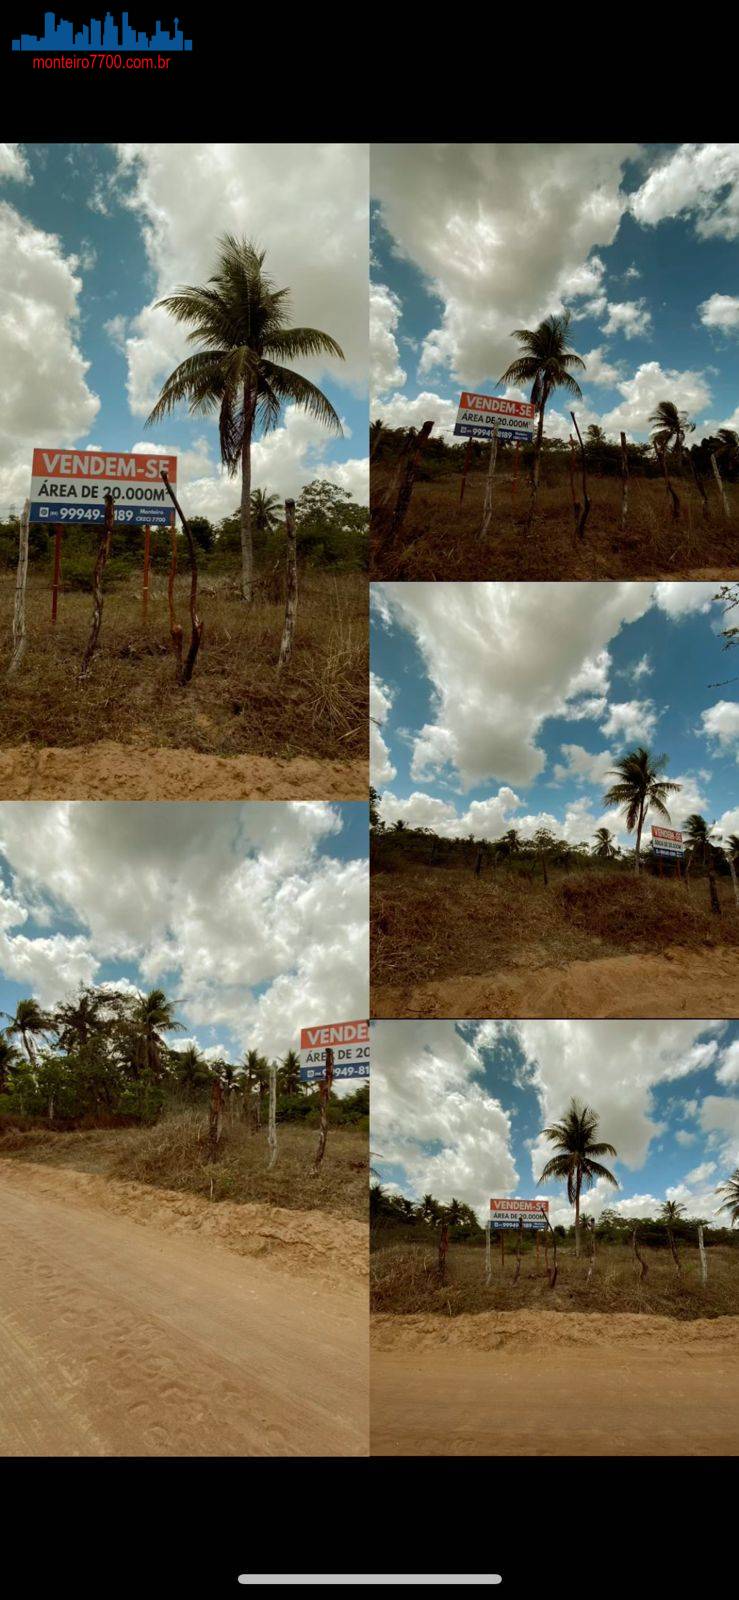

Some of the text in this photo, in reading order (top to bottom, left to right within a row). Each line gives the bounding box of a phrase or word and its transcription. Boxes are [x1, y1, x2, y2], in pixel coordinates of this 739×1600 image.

[467, 395, 532, 417] VENDEM-SE
[42, 453, 169, 479] VENDEM-SE
[38, 479, 77, 498] ÁREA
[81, 485, 99, 498] DE
[59, 507, 134, 522] 99949-189
[306, 1022, 368, 1045] VENDE
[305, 1046, 370, 1063] ÁRE DE 20
[322, 1065, 370, 1077] 9949-81
[493, 1200, 547, 1211] VENDEM-SE
